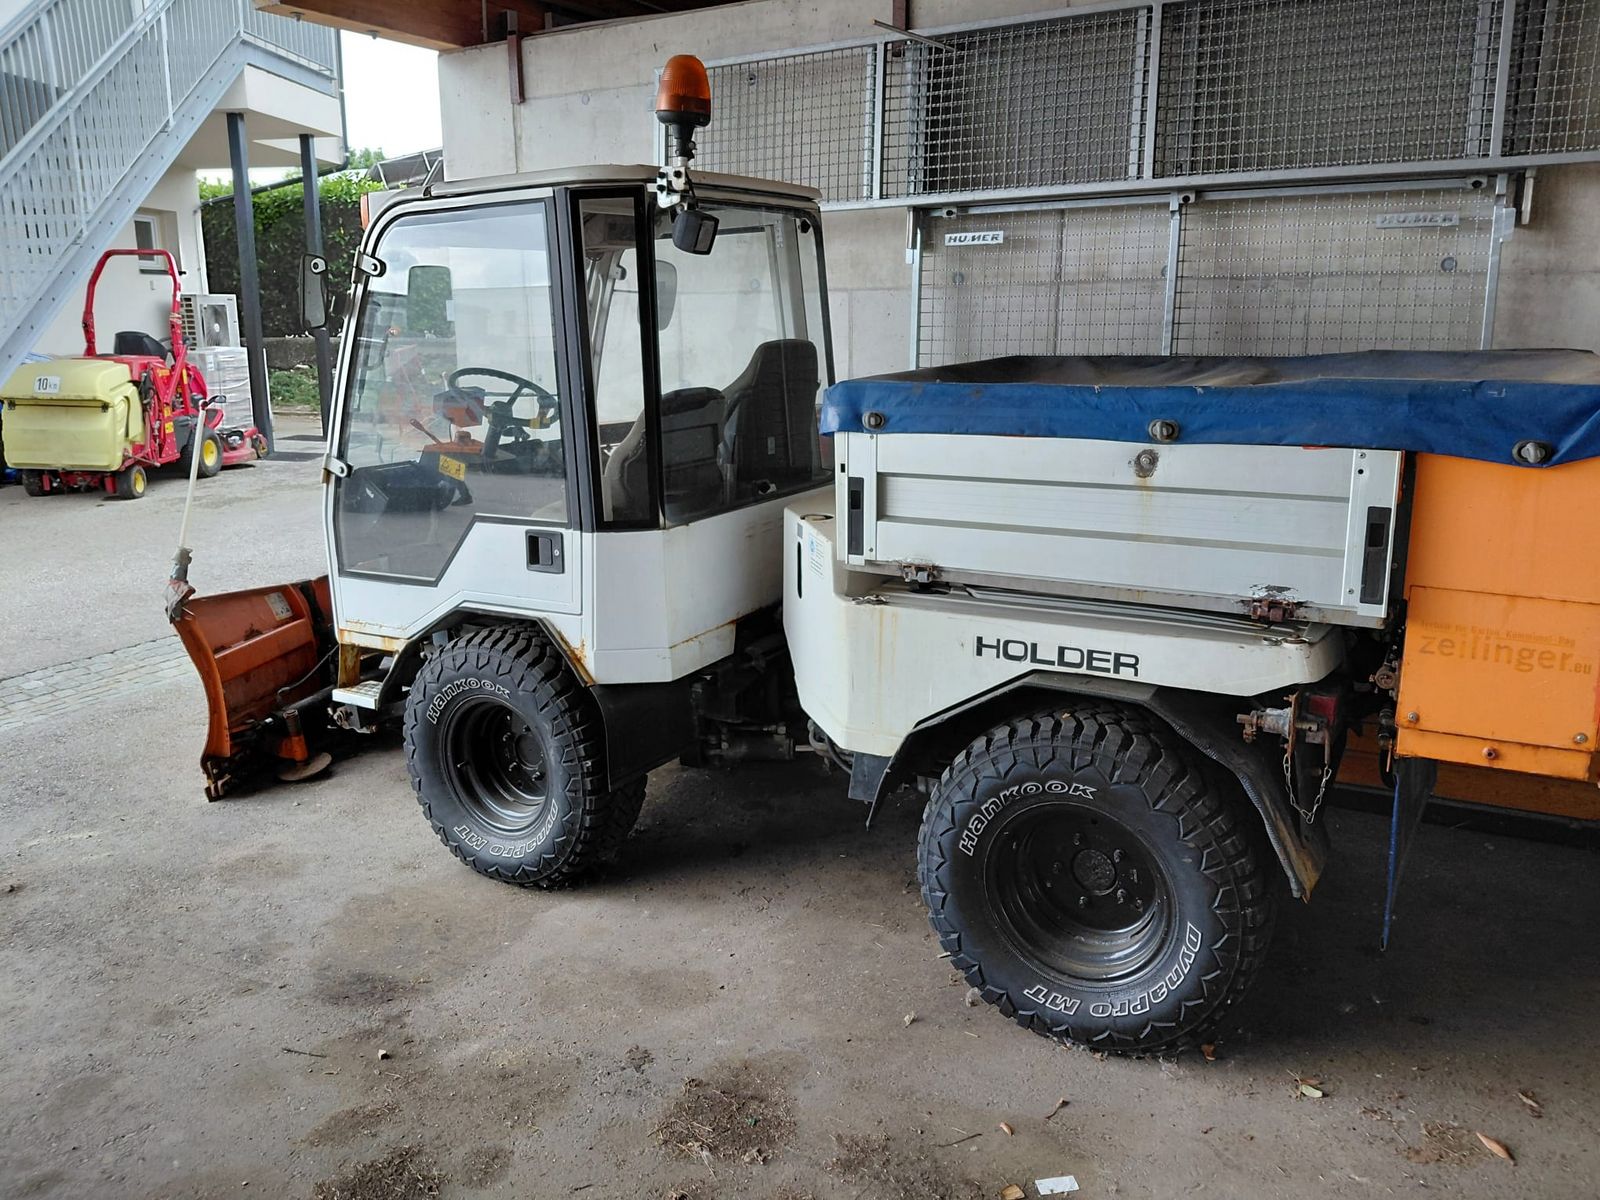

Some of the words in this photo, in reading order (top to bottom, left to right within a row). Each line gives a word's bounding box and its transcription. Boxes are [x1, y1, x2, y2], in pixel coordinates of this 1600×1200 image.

[37, 377, 48, 391] 10
[976, 636, 1140, 677] HOLDER
[453, 824, 488, 851] MT
[1024, 985, 1082, 1016] MT
